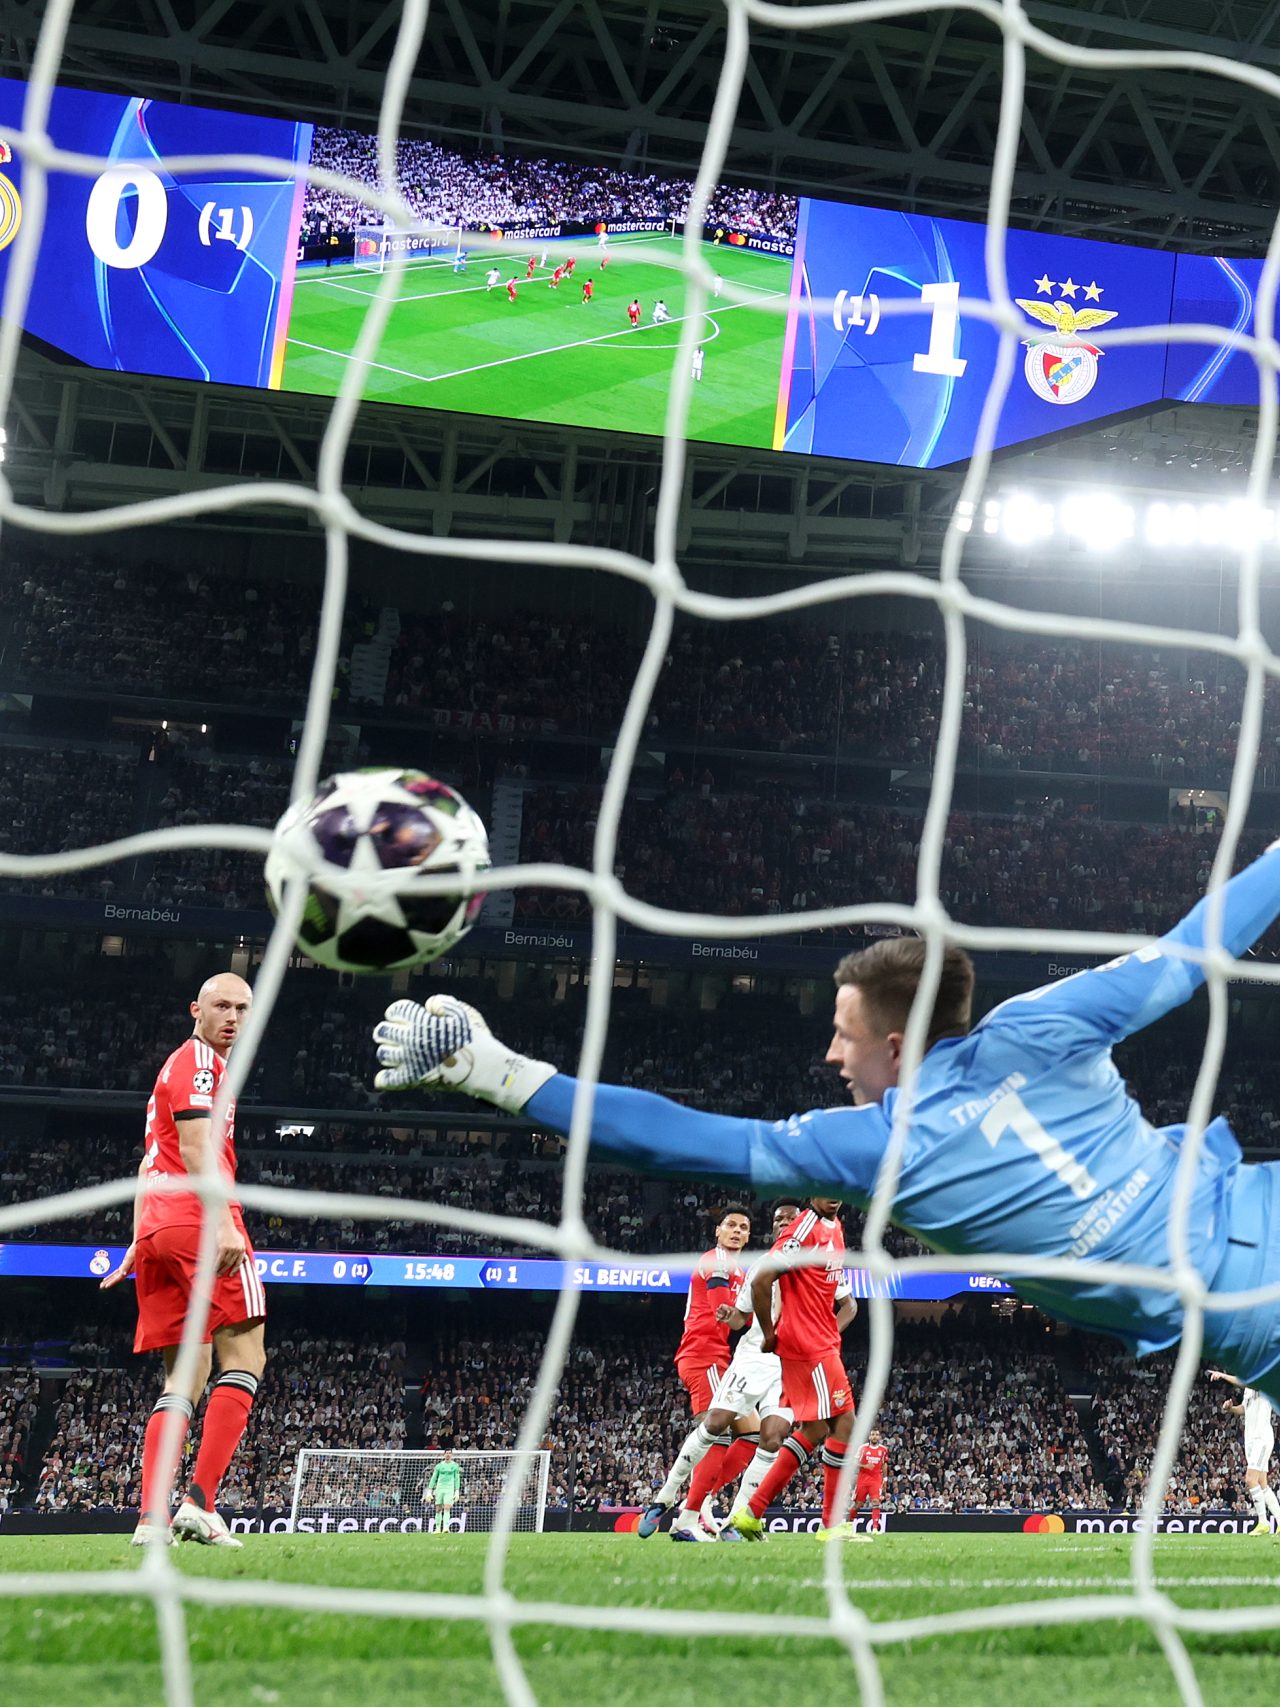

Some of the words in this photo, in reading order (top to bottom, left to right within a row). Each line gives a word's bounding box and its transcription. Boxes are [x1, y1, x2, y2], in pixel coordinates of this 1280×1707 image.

[86, 164, 168, 269] 0
[199, 200, 254, 251] (1)
[748, 237, 794, 255] maste
[832, 289, 881, 335] (1)
[912, 281, 968, 378] 1
[104, 904, 181, 923] Bernabéu
[504, 930, 574, 948] Bernabéu
[692, 943, 759, 960] Bernabéu
[980, 1091, 1098, 1200] 1
[1064, 1168, 1151, 1260] UNDATION
[333, 1260, 347, 1279] 0
[404, 1262, 455, 1281] 15:48
[573, 1268, 594, 1285] SL
[596, 1269, 671, 1287] BENFICA
[969, 1276, 1002, 1288] UEFA
[728, 1372, 747, 1393] 14
